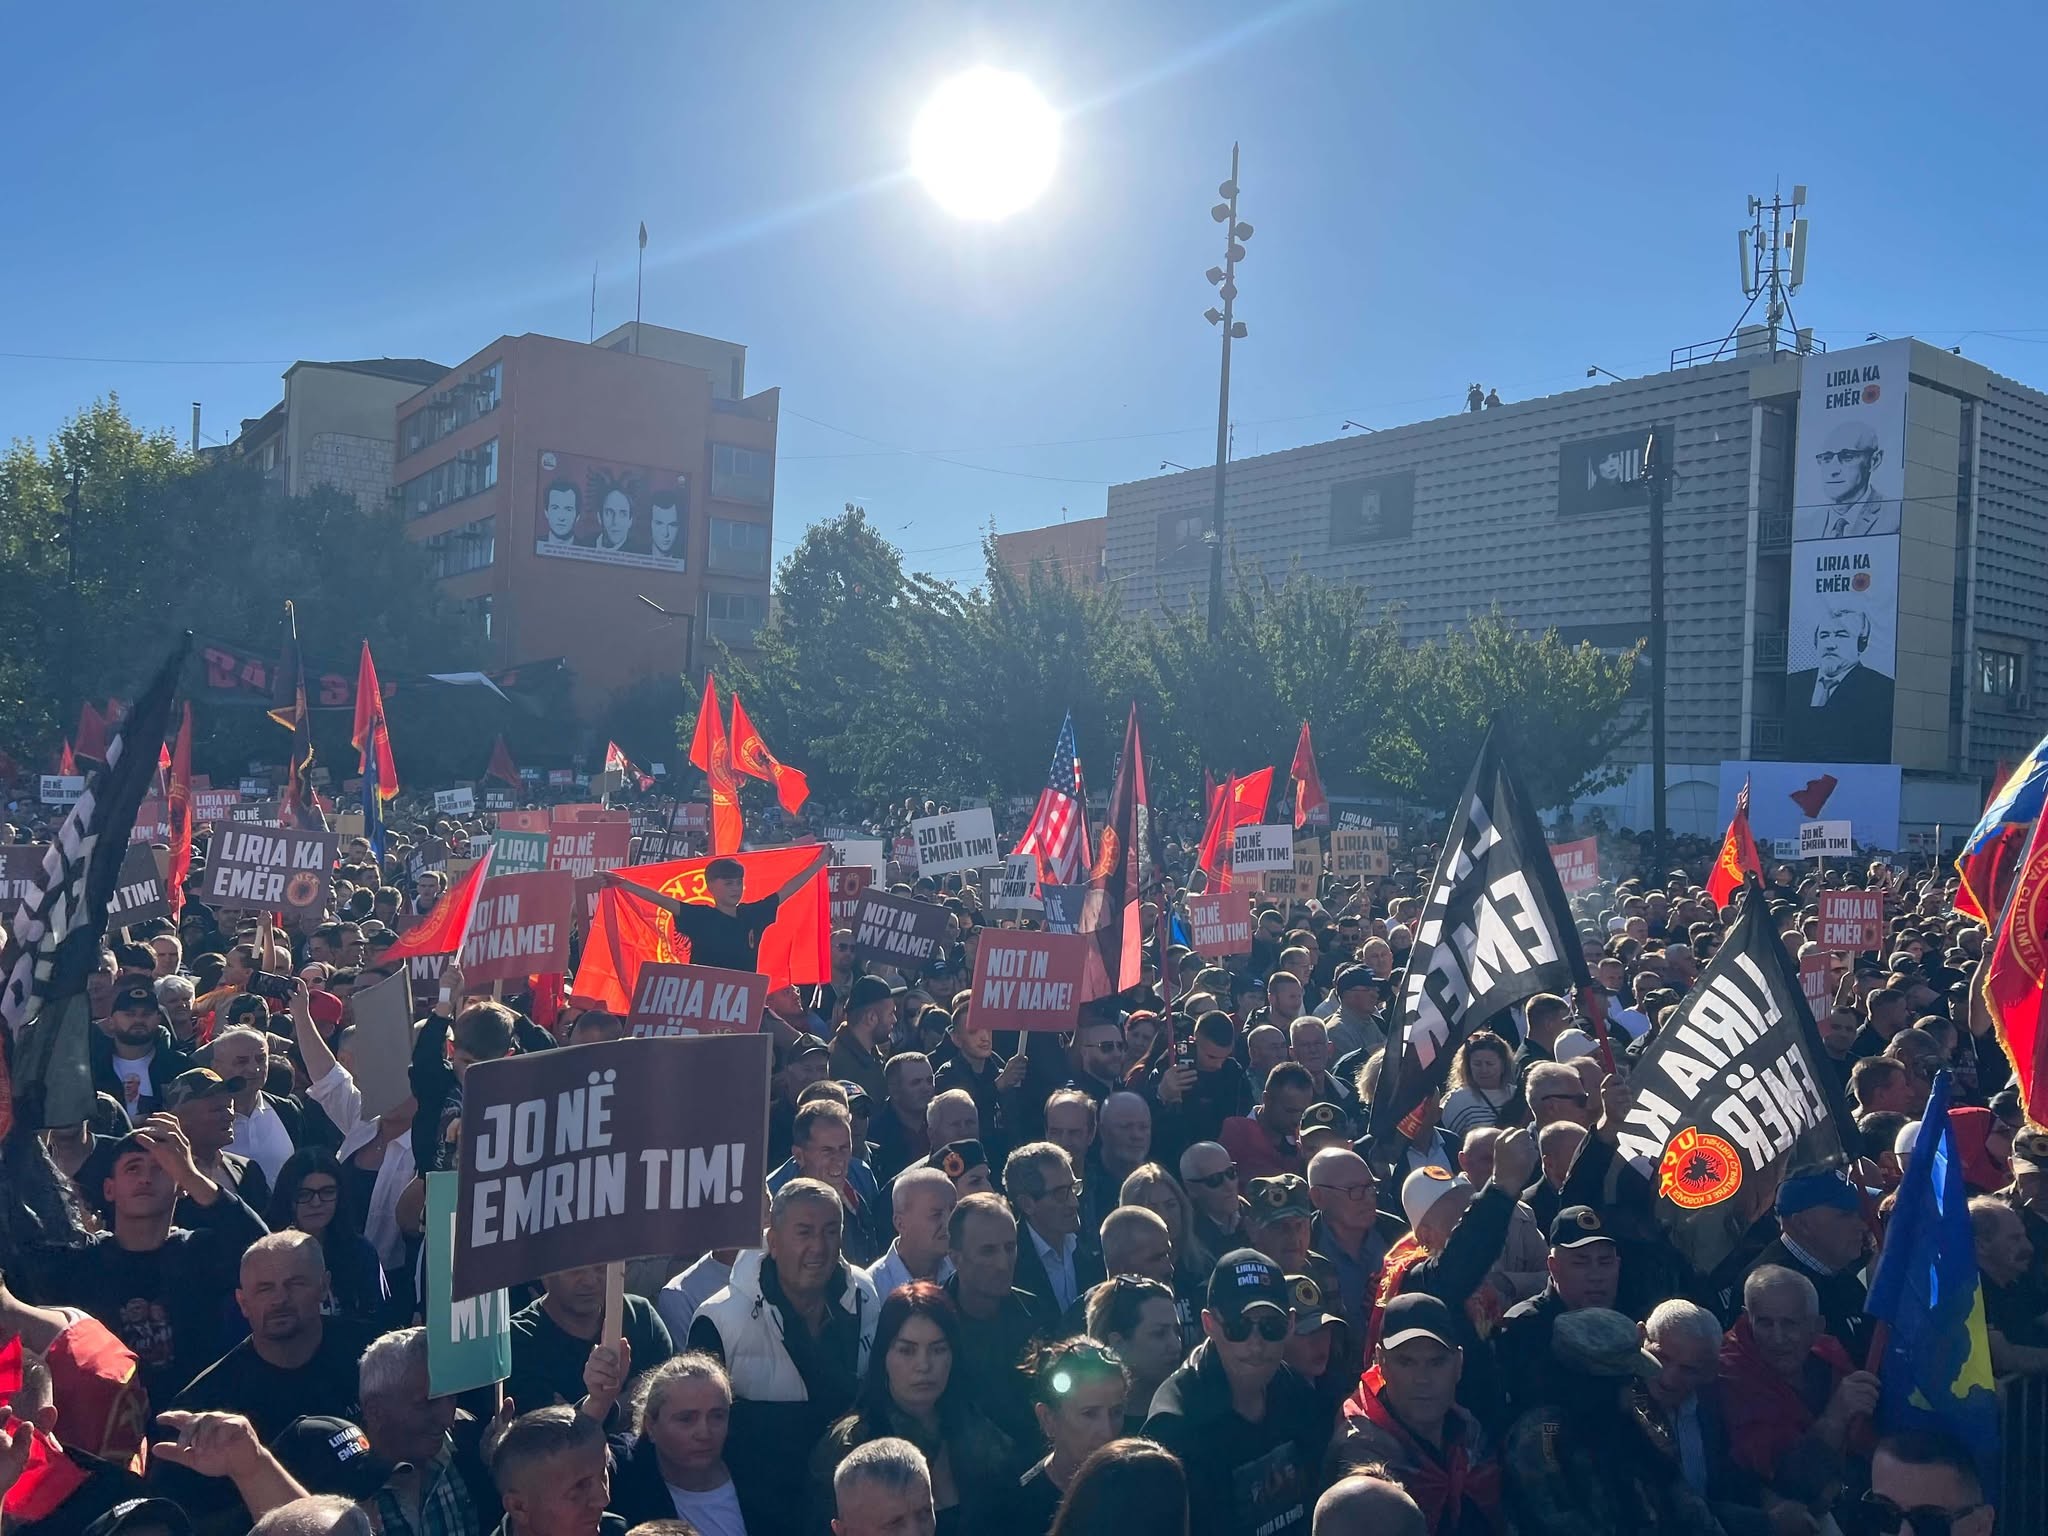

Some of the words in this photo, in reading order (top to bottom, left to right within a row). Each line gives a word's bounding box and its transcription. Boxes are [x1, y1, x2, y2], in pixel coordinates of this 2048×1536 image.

[1827, 369, 1859, 388] LIRIA
[1863, 365, 1880, 382] KA
[1825, 388, 1860, 410] EMËR
[1816, 555, 1850, 572] LIRIA
[1853, 553, 1870, 569] KA
[1815, 575, 1850, 593] EMËR
[196, 795, 222, 806] LIRIA
[224, 794, 237, 804] KA
[196, 806, 224, 819] EMËR
[233, 810, 247, 821] JO
[247, 807, 260, 820] NË
[1340, 811, 1361, 825] LIRIA
[1361, 815, 1372, 827] KA
[553, 835, 574, 856] JO
[576, 832, 595, 856] NË
[918, 827, 937, 846] JO
[939, 821, 957, 842] NË
[1235, 836, 1247, 849] JO
[1249, 832, 1261, 848] NË
[1337, 835, 1370, 851] LIRIA
[1371, 835, 1385, 850] KA
[1801, 829, 1812, 840] JO
[1813, 825, 1824, 838] NË
[1801, 839, 1826, 850] EMRIN
[1828, 838, 1848, 849] TIM!
[220, 831, 287, 868] LIRIA
[292, 840, 324, 870] KA
[497, 838, 539, 862] LIRIA
[671, 840, 689, 857] KA
[920, 842, 963, 864] EMRIN
[964, 838, 992, 856] TIM!
[1235, 849, 1265, 864] EMRIN
[1267, 848, 1289, 861] TIM!
[1338, 851, 1372, 870] EMËR
[1005, 864, 1016, 880] JO
[1017, 861, 1028, 880] NË
[1300, 860, 1313, 876] KA
[121, 879, 160, 910] TIM!
[213, 866, 285, 903] EMËR
[1001, 881, 1025, 898] EMRIN
[1270, 873, 1296, 894] EMËR
[497, 894, 520, 926] IN
[862, 901, 898, 928] NOT
[899, 910, 918, 934] IN
[1194, 908, 1206, 926] JO
[1208, 902, 1220, 924] NË
[1826, 898, 1861, 919] LIRIA
[1863, 898, 1878, 919] KA
[487, 923, 556, 961] NAME!
[856, 923, 885, 947] MY
[885, 930, 936, 959] NAME!
[1195, 925, 1225, 946] EMRIN
[1227, 922, 1248, 940] TIM!
[1824, 920, 1862, 944] EMËR
[411, 955, 444, 980] MY
[986, 948, 1026, 978] NOT
[1028, 950, 1049, 979] IN
[638, 975, 705, 1018] LIRIA
[708, 982, 749, 1025] KA
[982, 979, 1016, 1010] MY
[1017, 981, 1074, 1011] NAME!
[475, 1098, 547, 1172] JO
[555, 1068, 617, 1155] NË
[471, 1151, 626, 1248] EMRIN
[639, 1143, 746, 1210] TIM!
[451, 1294, 492, 1344] MY
